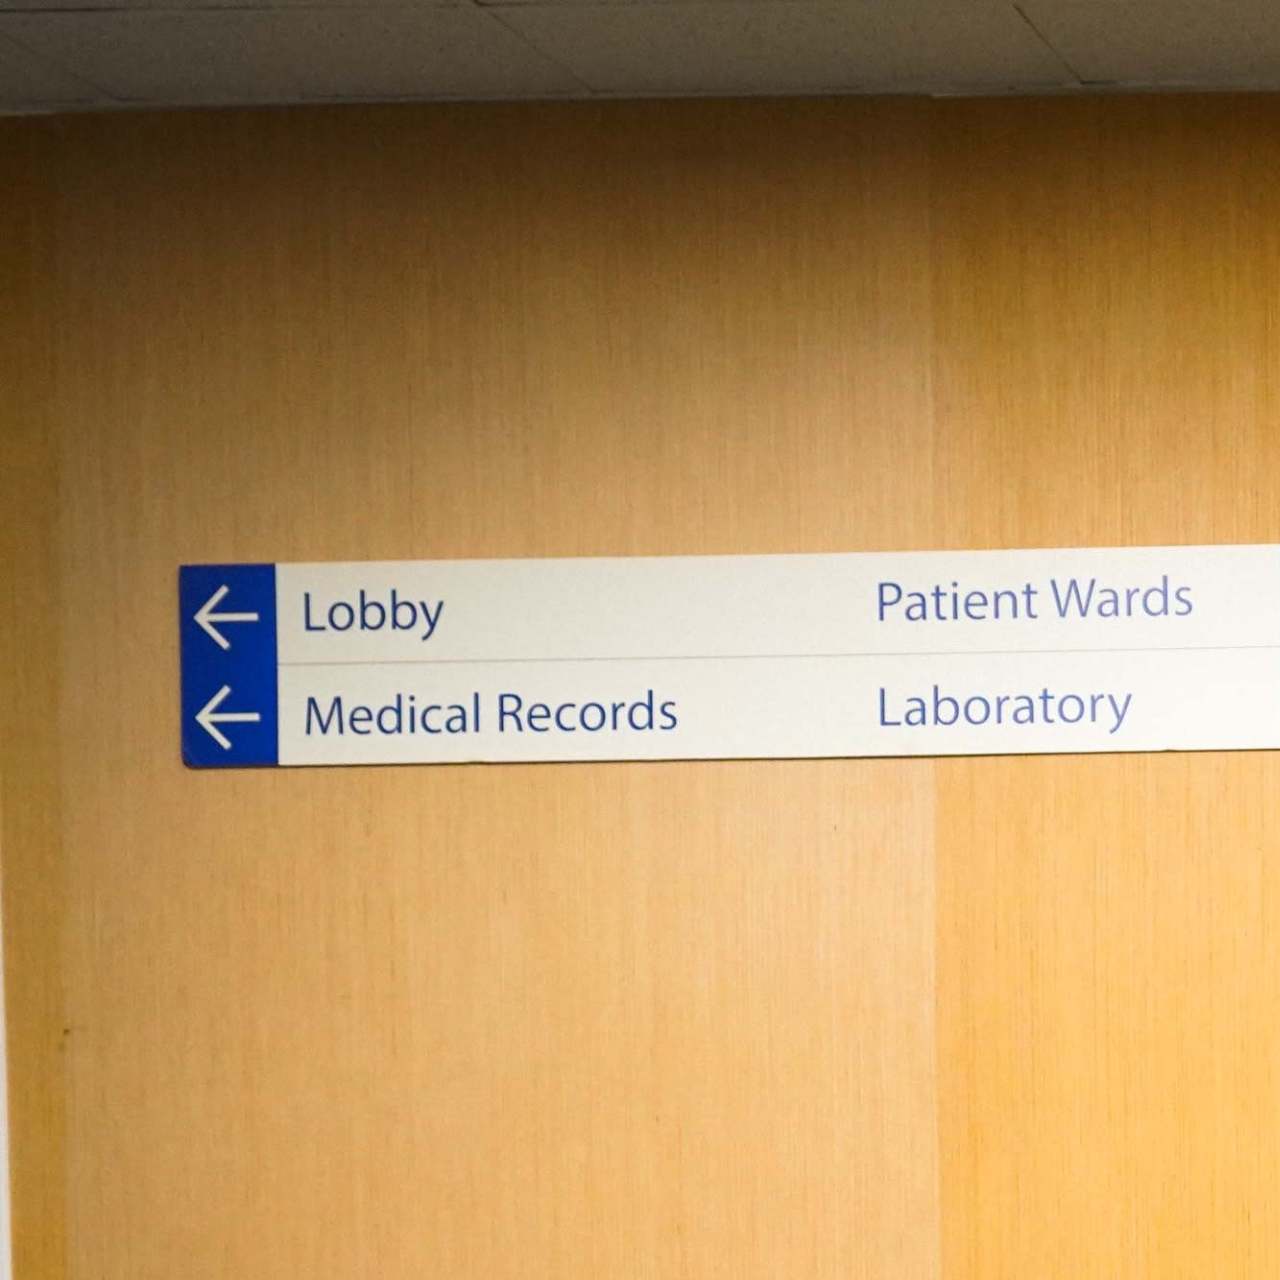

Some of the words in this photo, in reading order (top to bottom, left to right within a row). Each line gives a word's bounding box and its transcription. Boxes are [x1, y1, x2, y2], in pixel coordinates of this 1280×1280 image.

[303, 589, 444, 641] Lobby
[877, 581, 1038, 623] Patient
[1051, 575, 1195, 619] Wards
[306, 692, 481, 738] Medical
[498, 689, 678, 734] Records
[879, 685, 1133, 734] Laboratory
